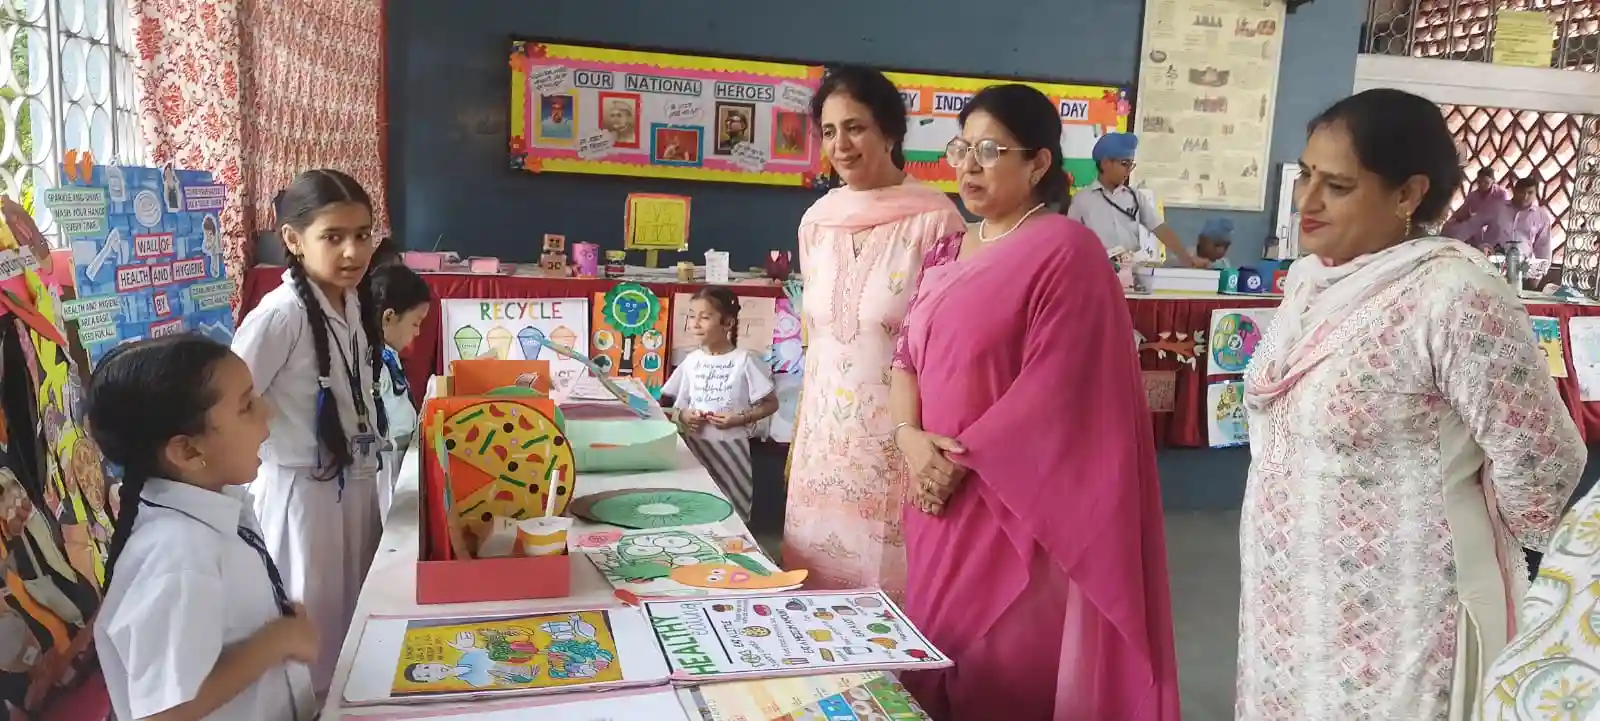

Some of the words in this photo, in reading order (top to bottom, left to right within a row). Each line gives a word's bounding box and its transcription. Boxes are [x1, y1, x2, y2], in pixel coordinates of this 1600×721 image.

[578, 72, 612, 86] OUR
[627, 77, 699, 94] NATIONAL
[717, 84, 772, 100] HEROES
[1060, 102, 1087, 118] DAY
[55, 208, 71, 217] WASH
[73, 208, 87, 217] YOUR
[138, 240, 158, 253] WALL
[161, 238, 170, 251] OF
[120, 269, 149, 287] HEALTH
[153, 268, 169, 282] AND
[175, 262, 203, 277] HYGIENE
[64, 304, 85, 316] HEALTH
[86, 302, 97, 311] AND
[156, 297, 165, 312] BY
[480, 301, 563, 320] RECYCLE
[680, 601, 710, 637] eating
[775, 608, 793, 624] AMOUNT
[721, 620, 738, 634] LITTLE
[655, 615, 721, 675] HEALTHY
[731, 639, 745, 647] EAT
